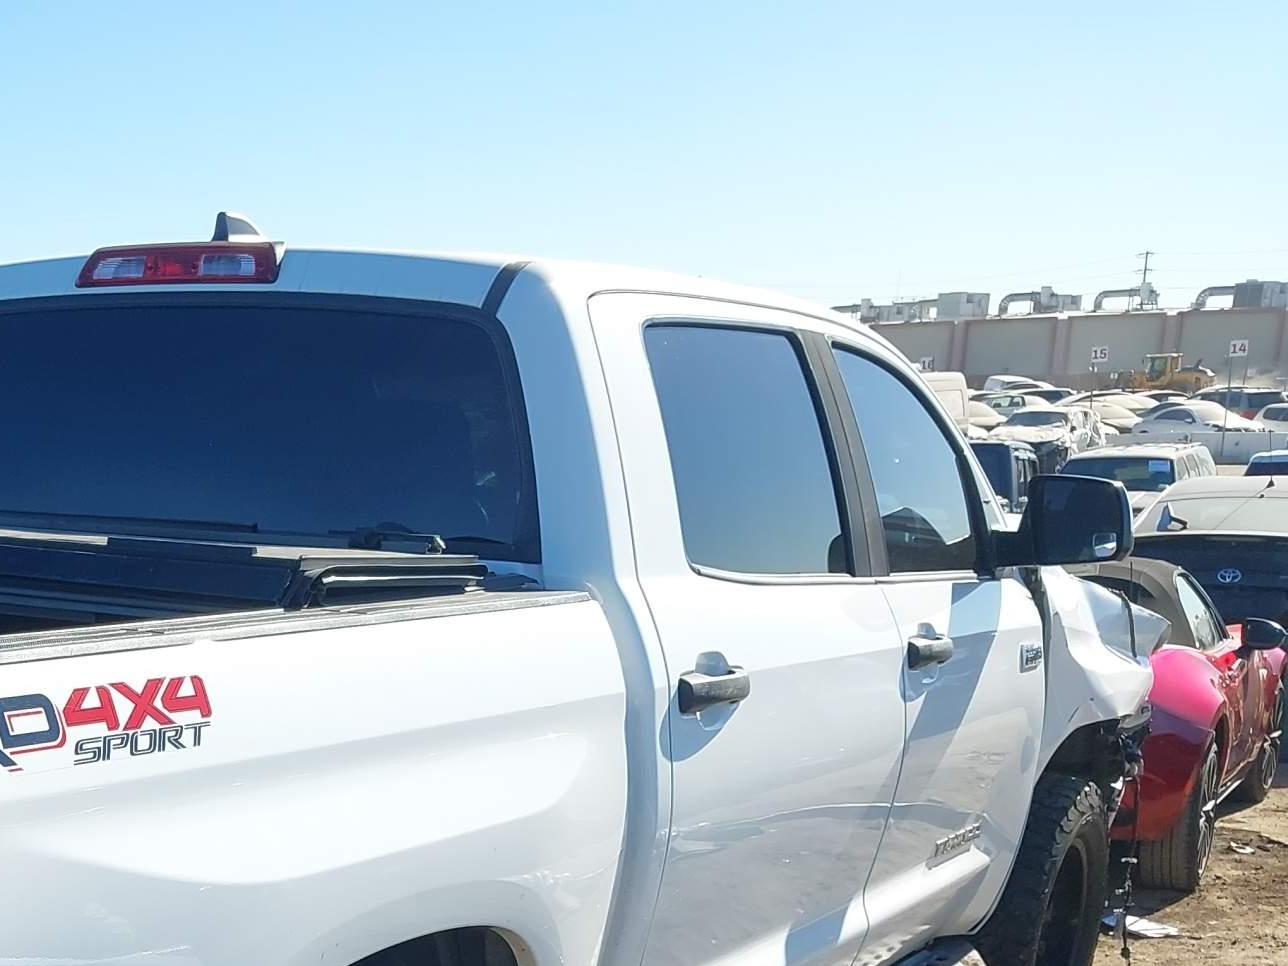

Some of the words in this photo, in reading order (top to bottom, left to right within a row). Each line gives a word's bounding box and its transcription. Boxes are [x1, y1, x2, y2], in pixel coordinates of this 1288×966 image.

[1093, 348, 1107, 359] 15
[1231, 343, 1246, 353] 14
[73, 721, 211, 766] SPORT
